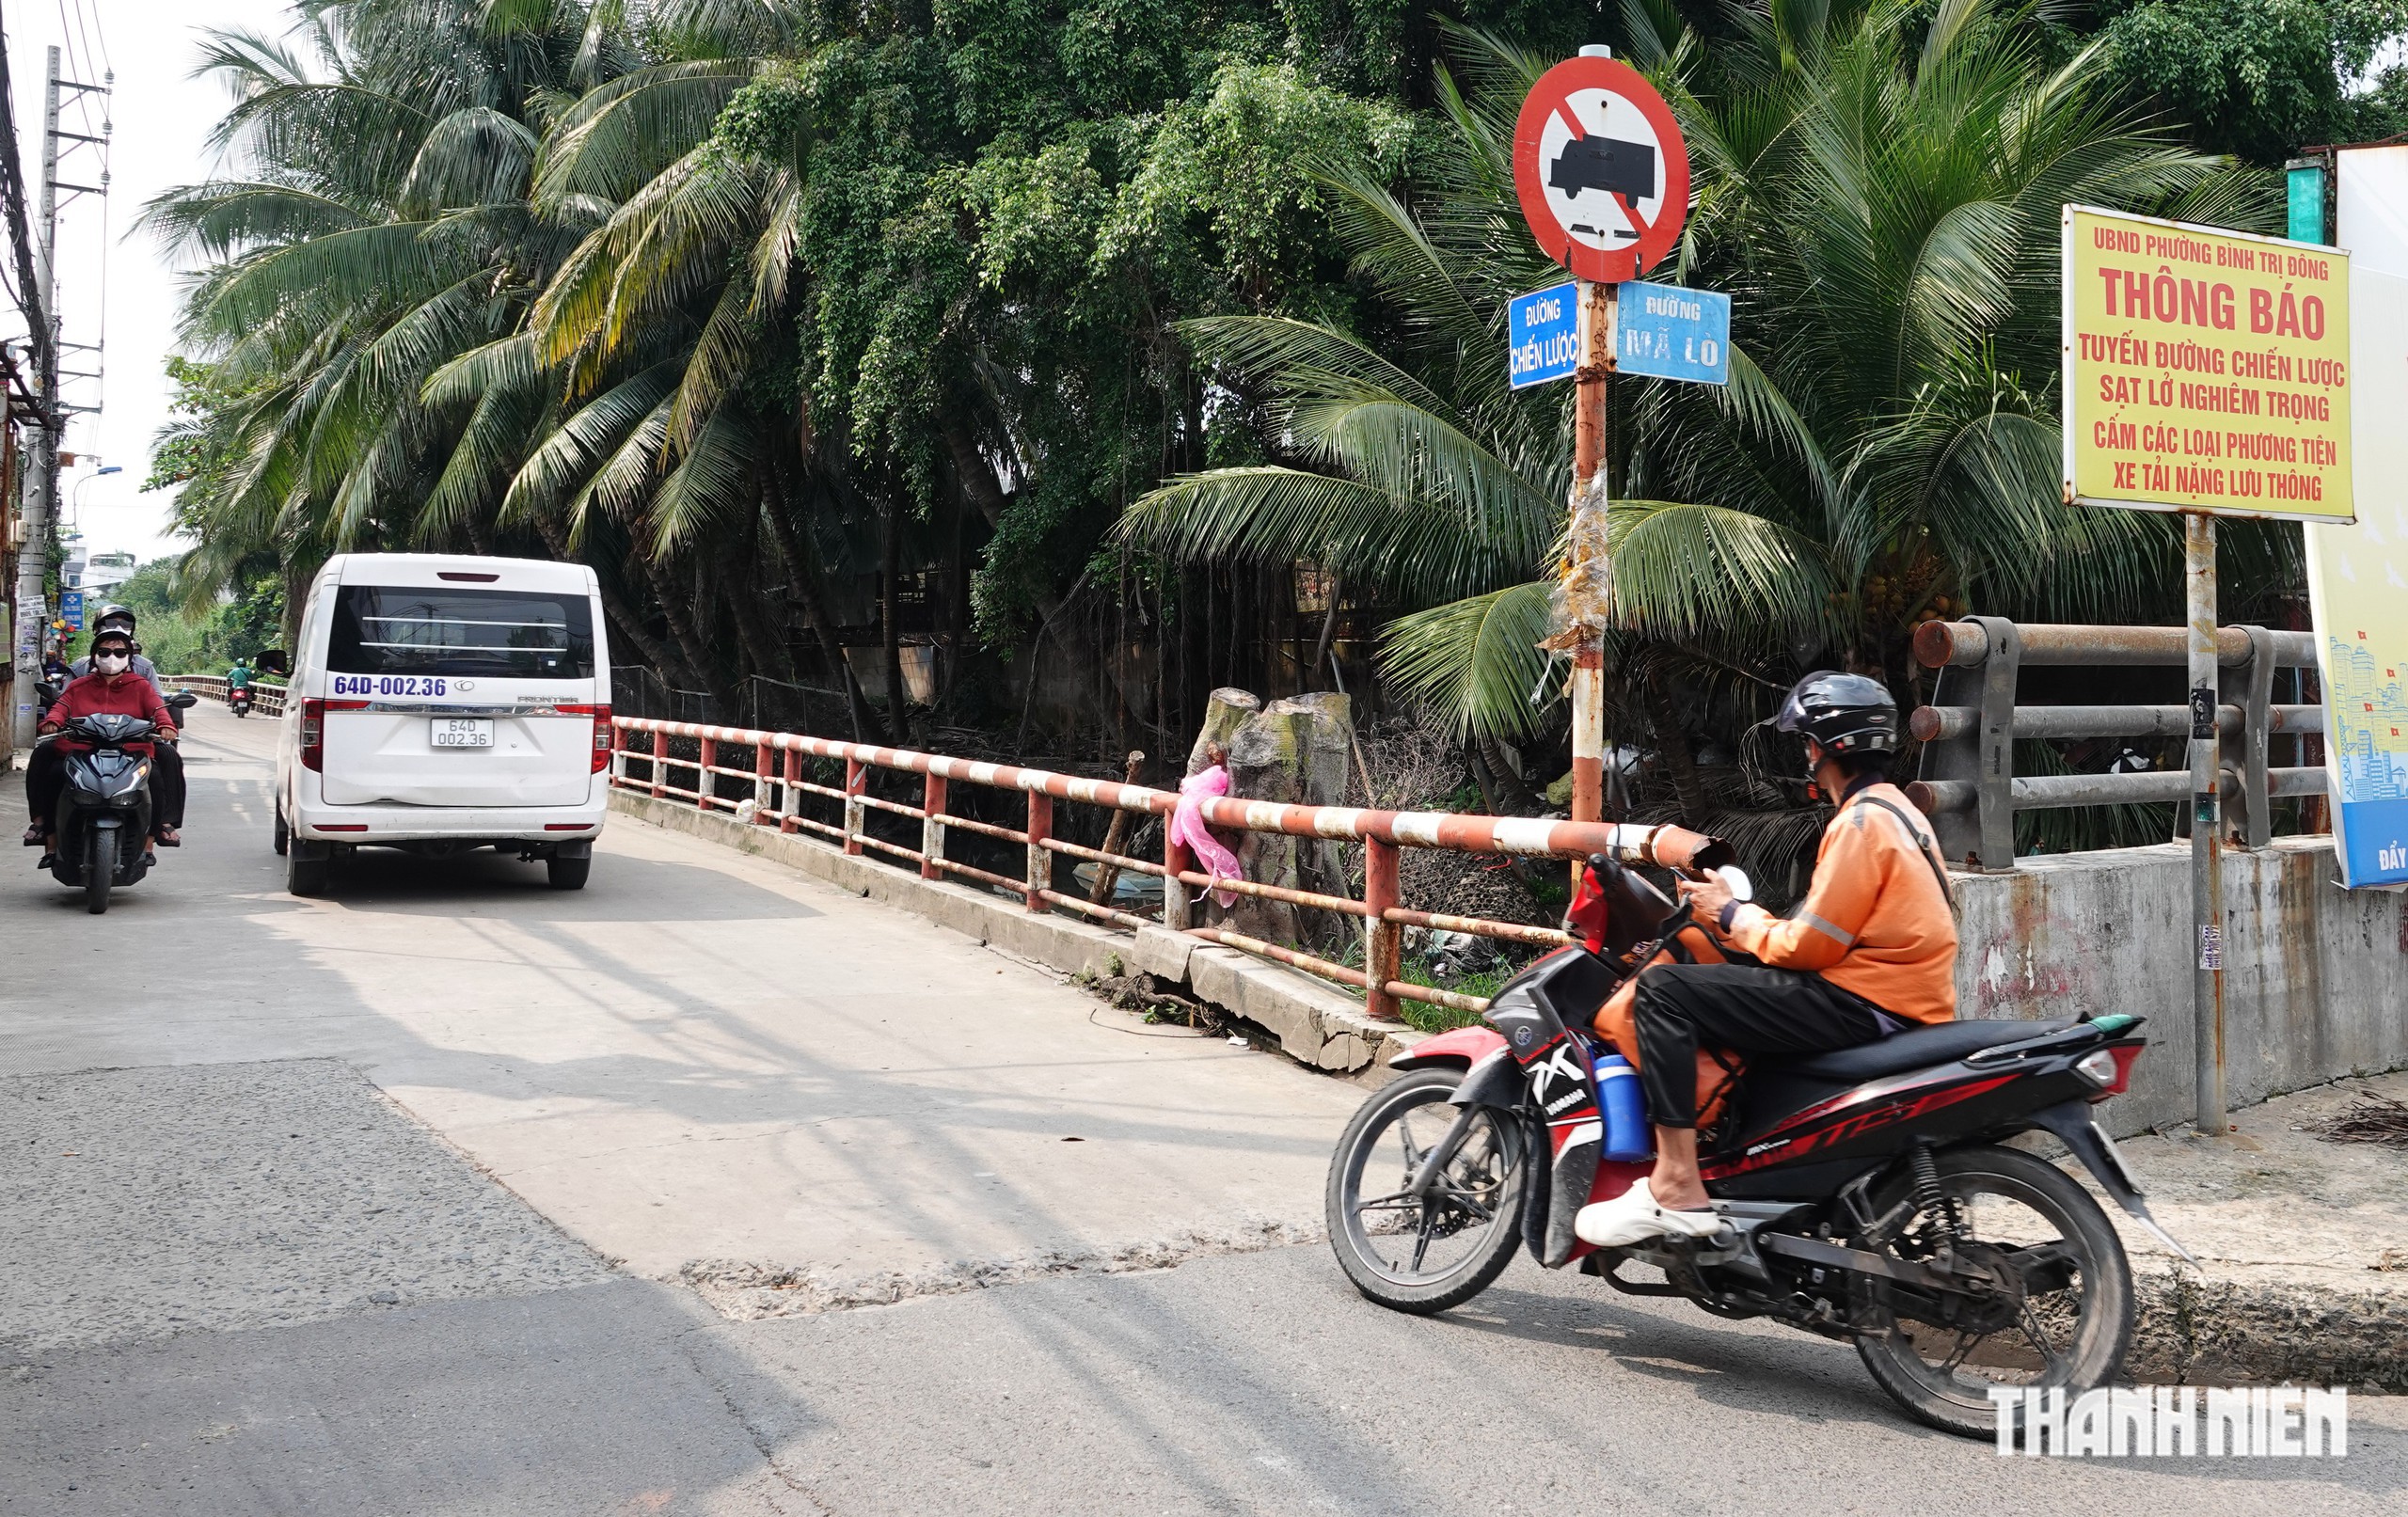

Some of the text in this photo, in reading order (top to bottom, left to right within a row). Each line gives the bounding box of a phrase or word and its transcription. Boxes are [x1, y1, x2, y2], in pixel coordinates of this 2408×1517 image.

[2094, 227, 2329, 281] UBND PHƯỜNG BÌNH TRỊ ĐÔNG
[1526, 296, 1561, 327] ĐƯỜNG
[1646, 294, 1702, 322] ĐƯỜNG
[2099, 265, 2325, 340] THÔNG BÁO
[1512, 329, 1577, 375] CHIẾN LƯỢC
[1684, 332, 1719, 367] LÒ
[2079, 330, 2345, 391] TUYẾN ĐƯỜNG CHIẾN LƯỢC
[2099, 371, 2330, 424] SẠT LỞ NGHIÊM TRỌNG
[2094, 413, 2337, 470] CẤM CÁC LOẠI PHƯƠNG TIỆN
[2113, 455, 2322, 501] XE TẢI NẶNG LƯU THÔNG
[335, 676, 446, 697] 64D-002.36
[517, 695, 579, 703] FRONTIER
[438, 734, 487, 745] 002.36
[449, 719, 476, 732] 64D
[2379, 840, 2406, 871] ĐẨY
[1545, 1088, 1587, 1116] YAMAHA
